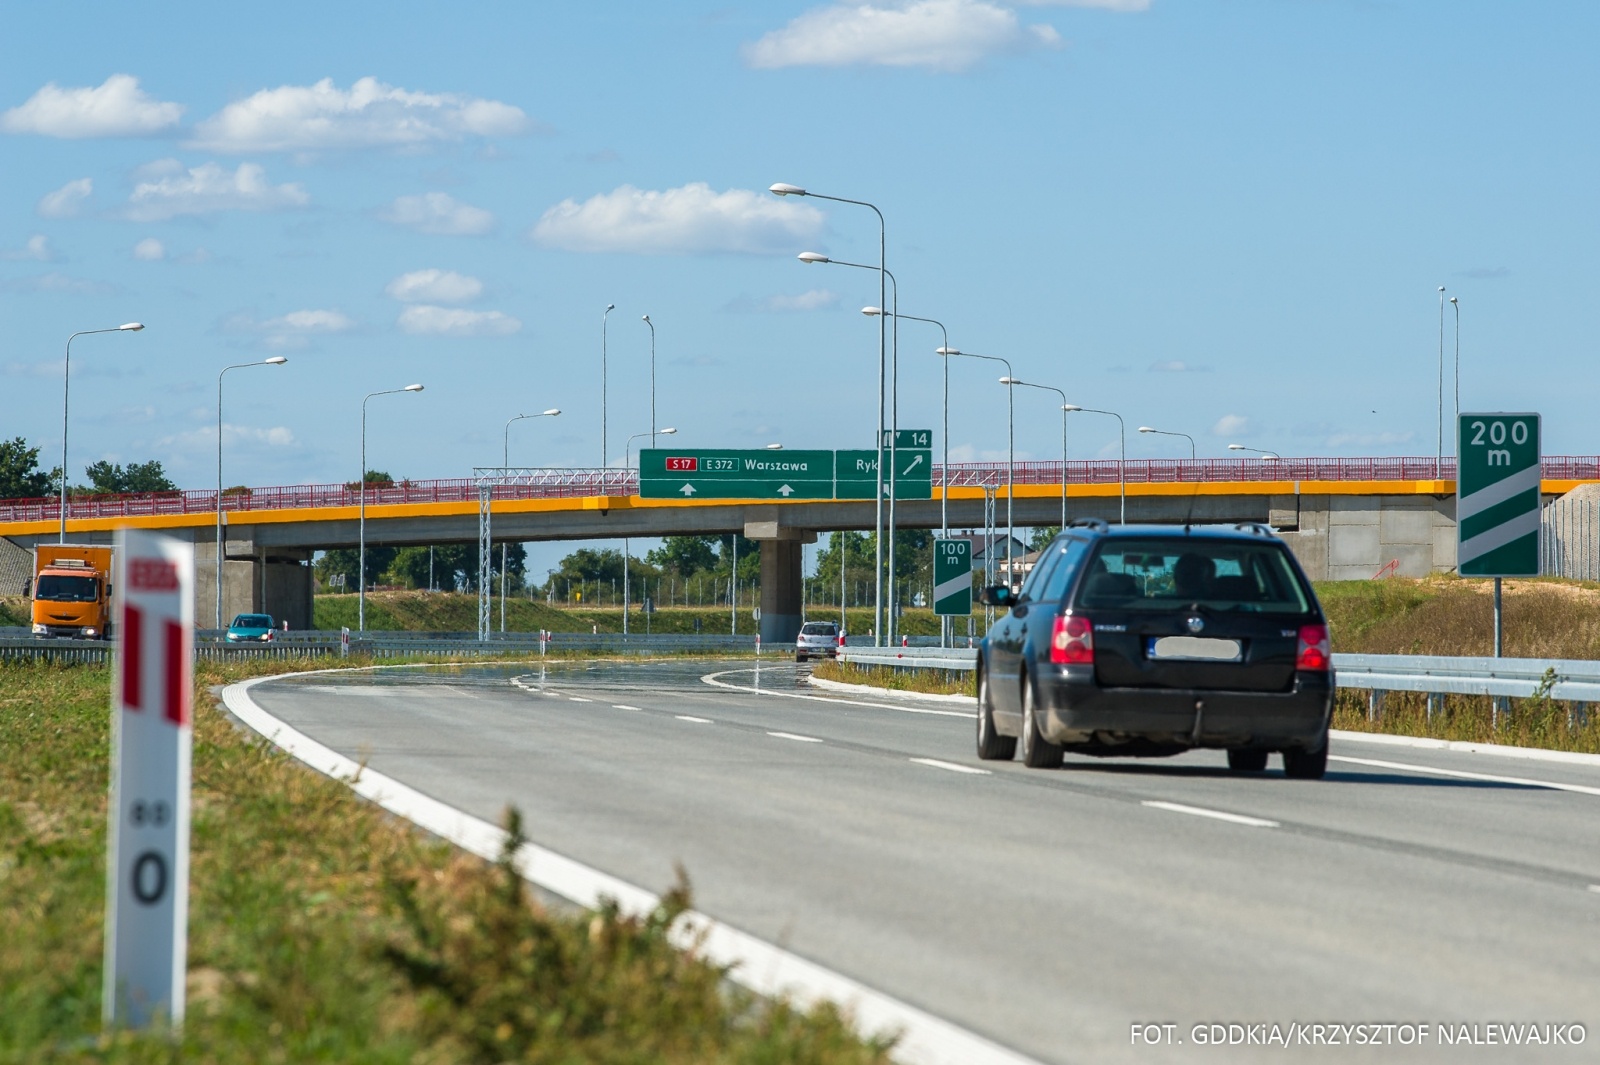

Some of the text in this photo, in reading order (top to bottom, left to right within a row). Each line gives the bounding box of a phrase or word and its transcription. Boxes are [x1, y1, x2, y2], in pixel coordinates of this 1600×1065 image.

[912, 432, 928, 446] 14
[1470, 421, 1528, 445] 200
[1487, 449, 1511, 466] m
[714, 460, 733, 470] 372
[744, 459, 808, 471] Warszawa
[856, 459, 881, 473] Ryk
[941, 543, 966, 555] 100
[947, 556, 959, 565] m
